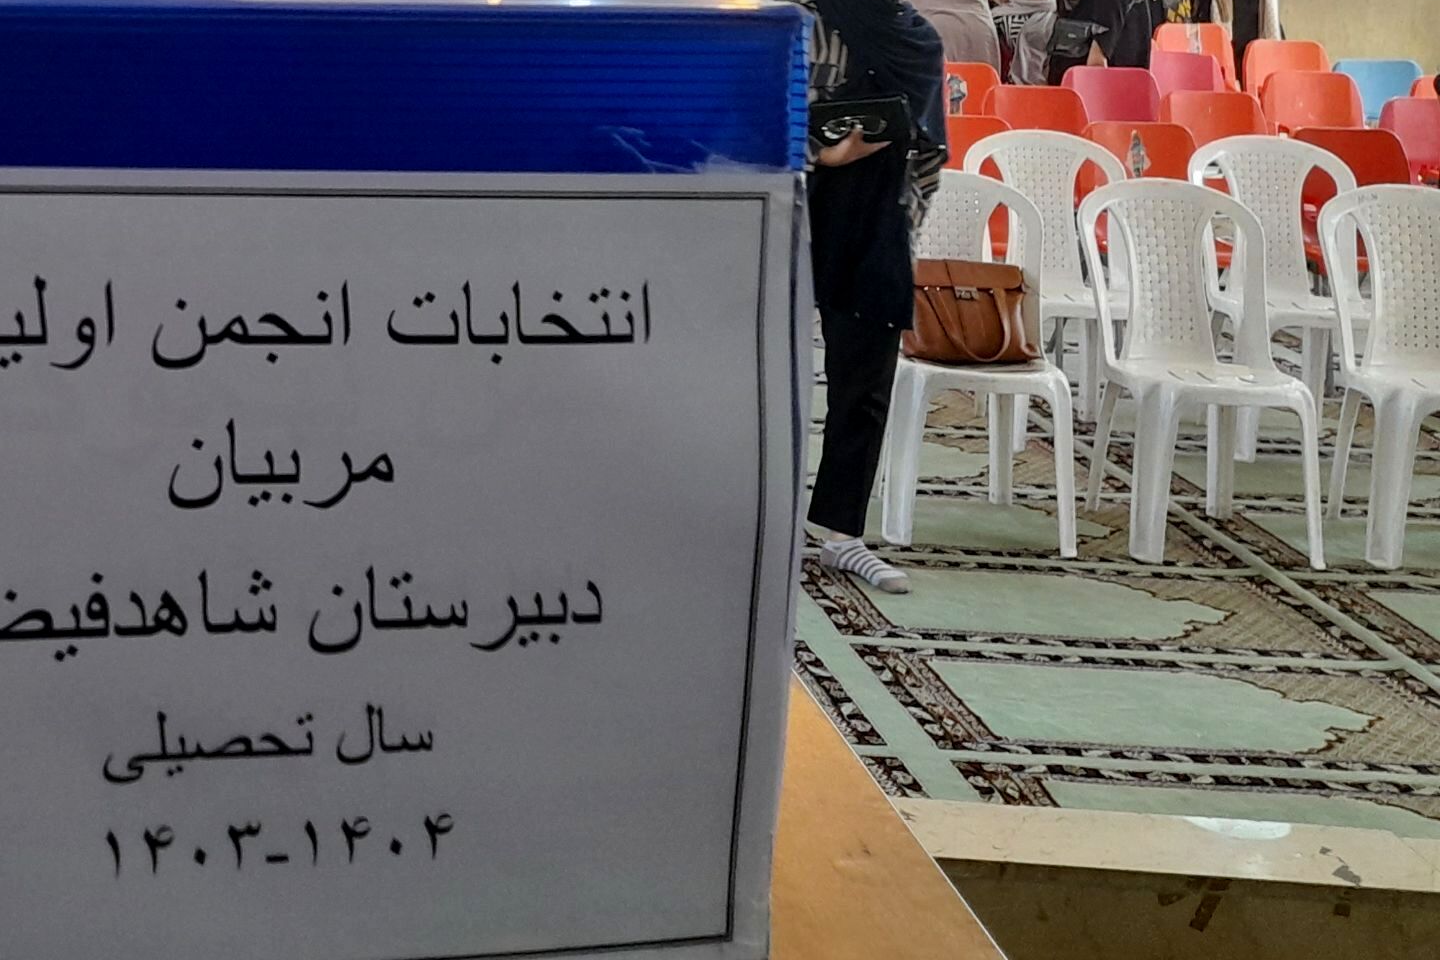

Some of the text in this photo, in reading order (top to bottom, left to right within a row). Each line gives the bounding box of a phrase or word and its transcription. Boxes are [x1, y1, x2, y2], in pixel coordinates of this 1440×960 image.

[150, 279, 352, 371] انجمن
[385, 279, 652, 366] انتخابات
[166, 416, 396, 511] مربیان
[306, 564, 604, 657] دبیرستان
[100, 701, 435, 787] سال تحصیلی
